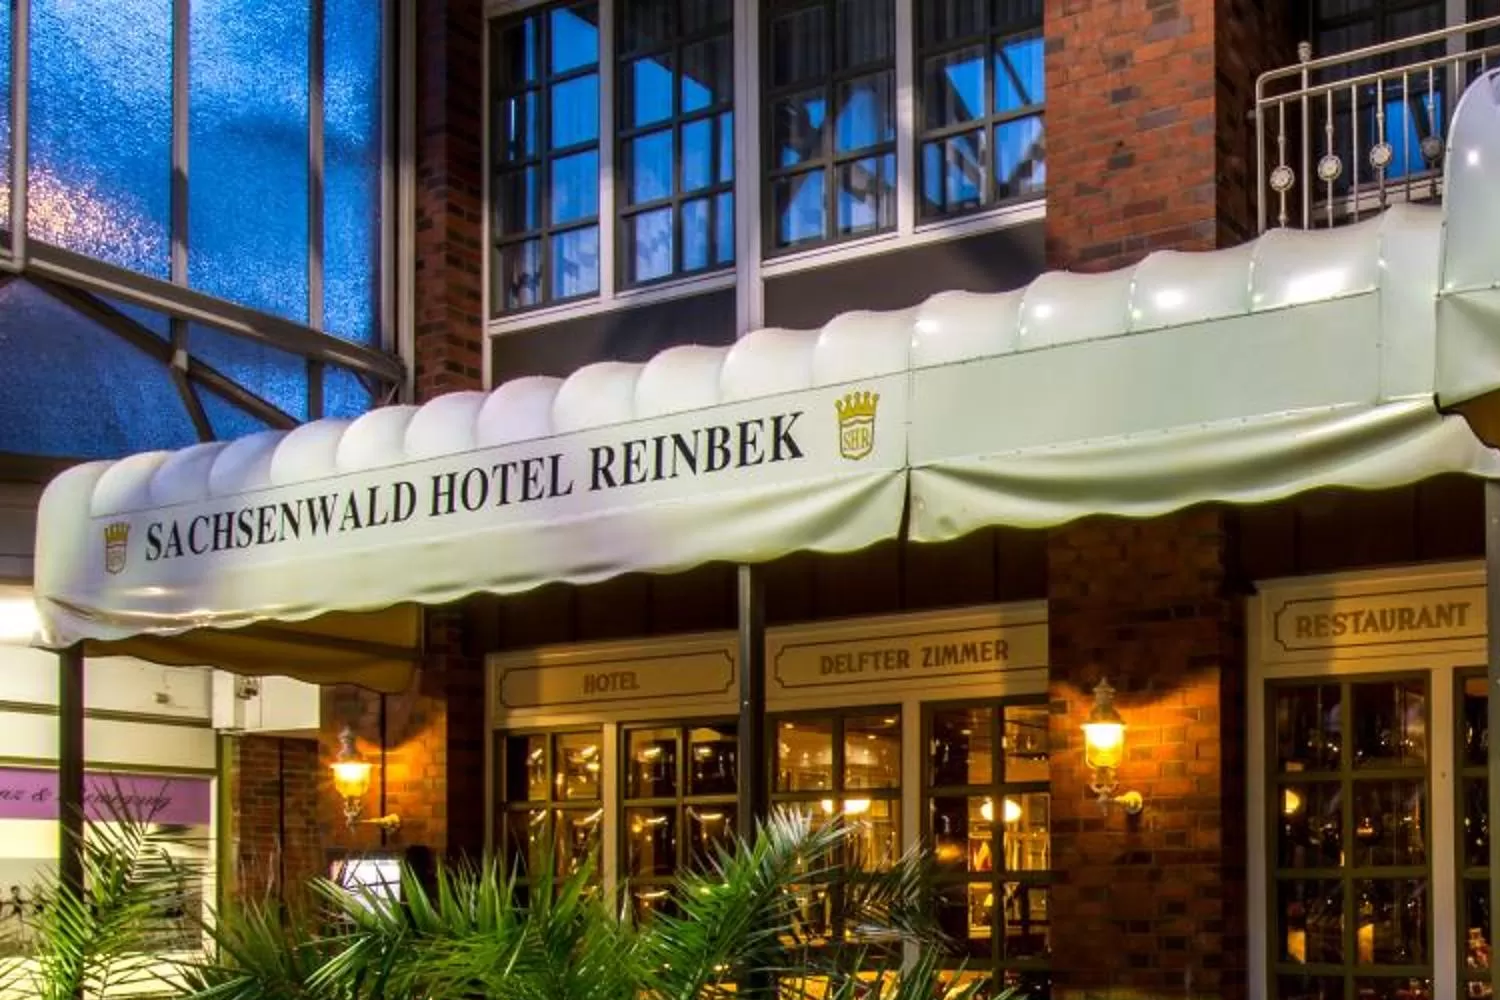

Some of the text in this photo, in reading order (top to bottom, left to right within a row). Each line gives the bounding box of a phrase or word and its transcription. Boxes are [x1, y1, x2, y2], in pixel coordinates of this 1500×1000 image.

[145, 412, 804, 561] SACHSENWALD HOTEL REINBEK
[1295, 601, 1471, 639] RESTAURANT
[819, 638, 1010, 676] DELFTER ZIMMER
[582, 670, 641, 694] HOTEL
